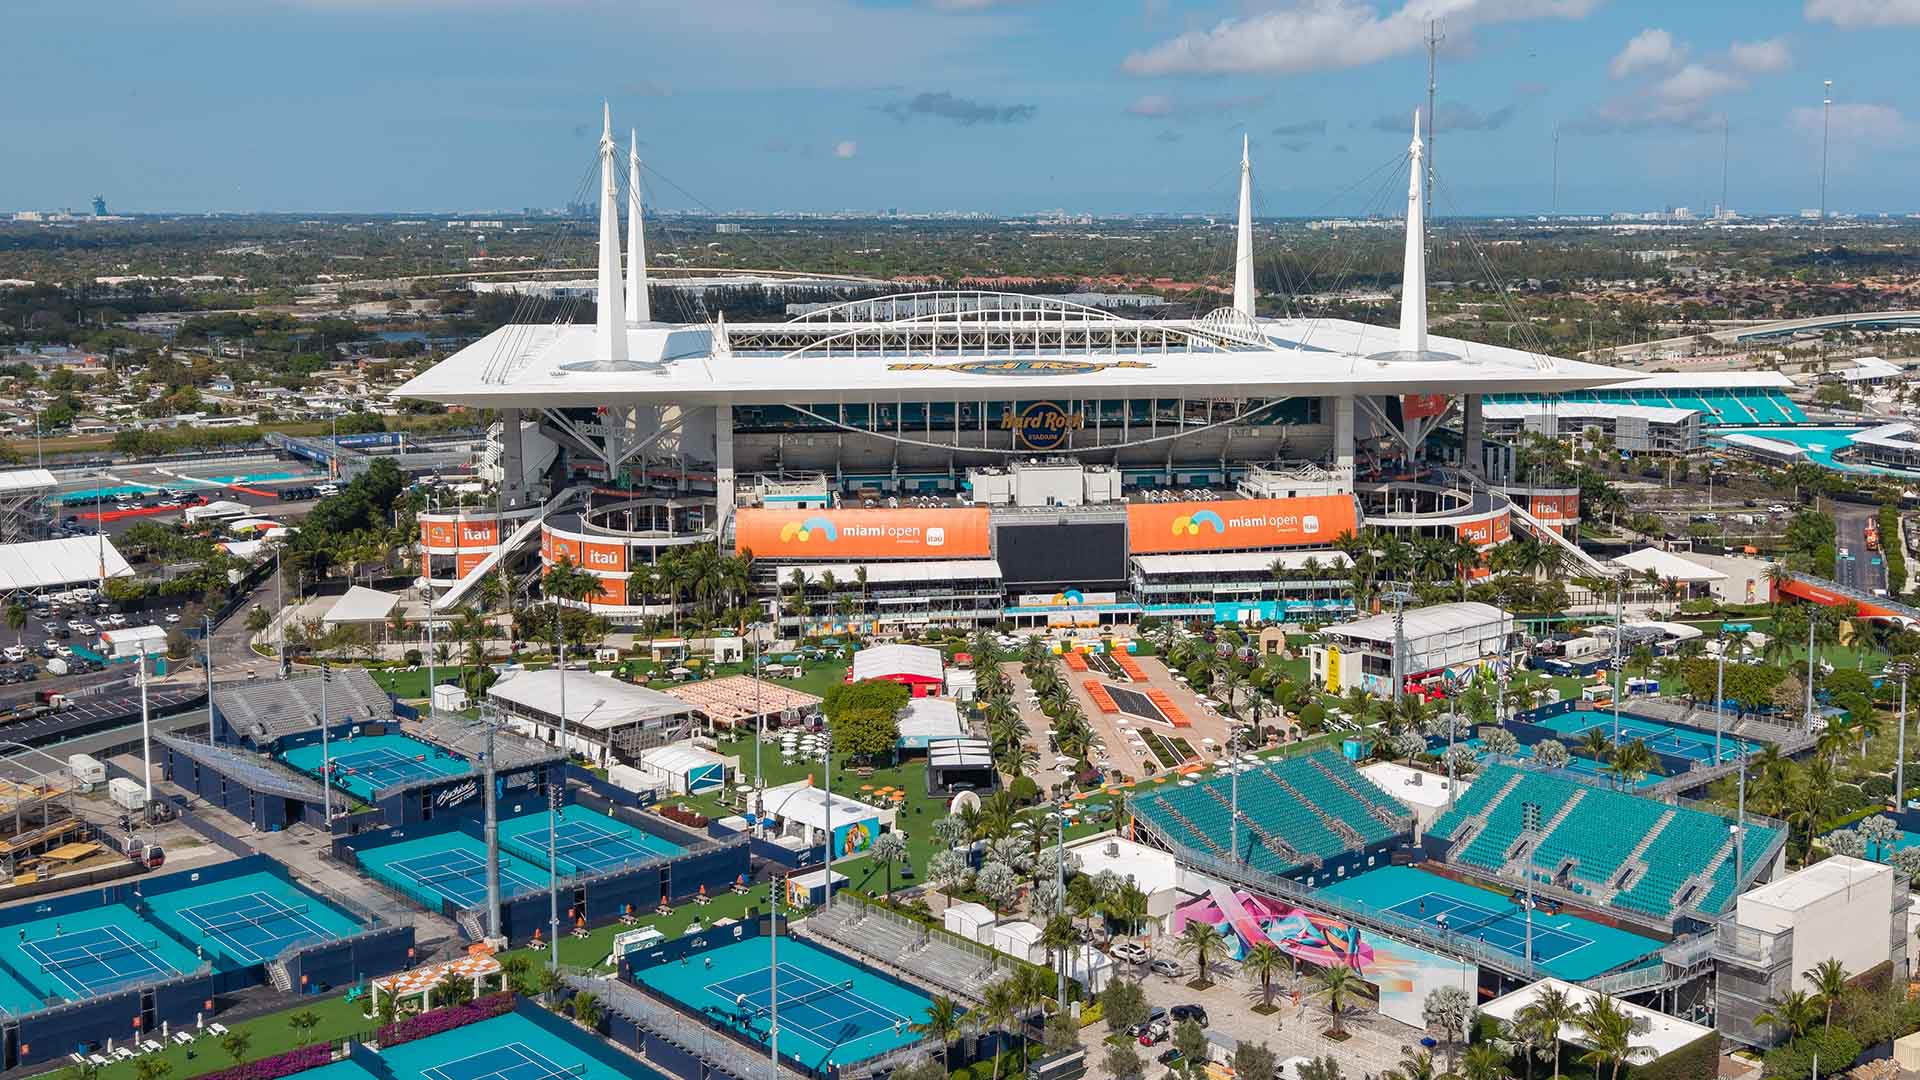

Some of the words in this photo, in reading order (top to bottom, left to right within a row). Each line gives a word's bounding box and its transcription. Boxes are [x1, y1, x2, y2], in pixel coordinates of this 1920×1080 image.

[1000, 411, 1043, 430] Hard
[1044, 410, 1086, 432] Rock
[1028, 433, 1058, 441] STADIUM
[1229, 515, 1266, 528] miami
[1269, 515, 1298, 529] open
[843, 524, 885, 537] miami
[887, 527, 920, 539] open
